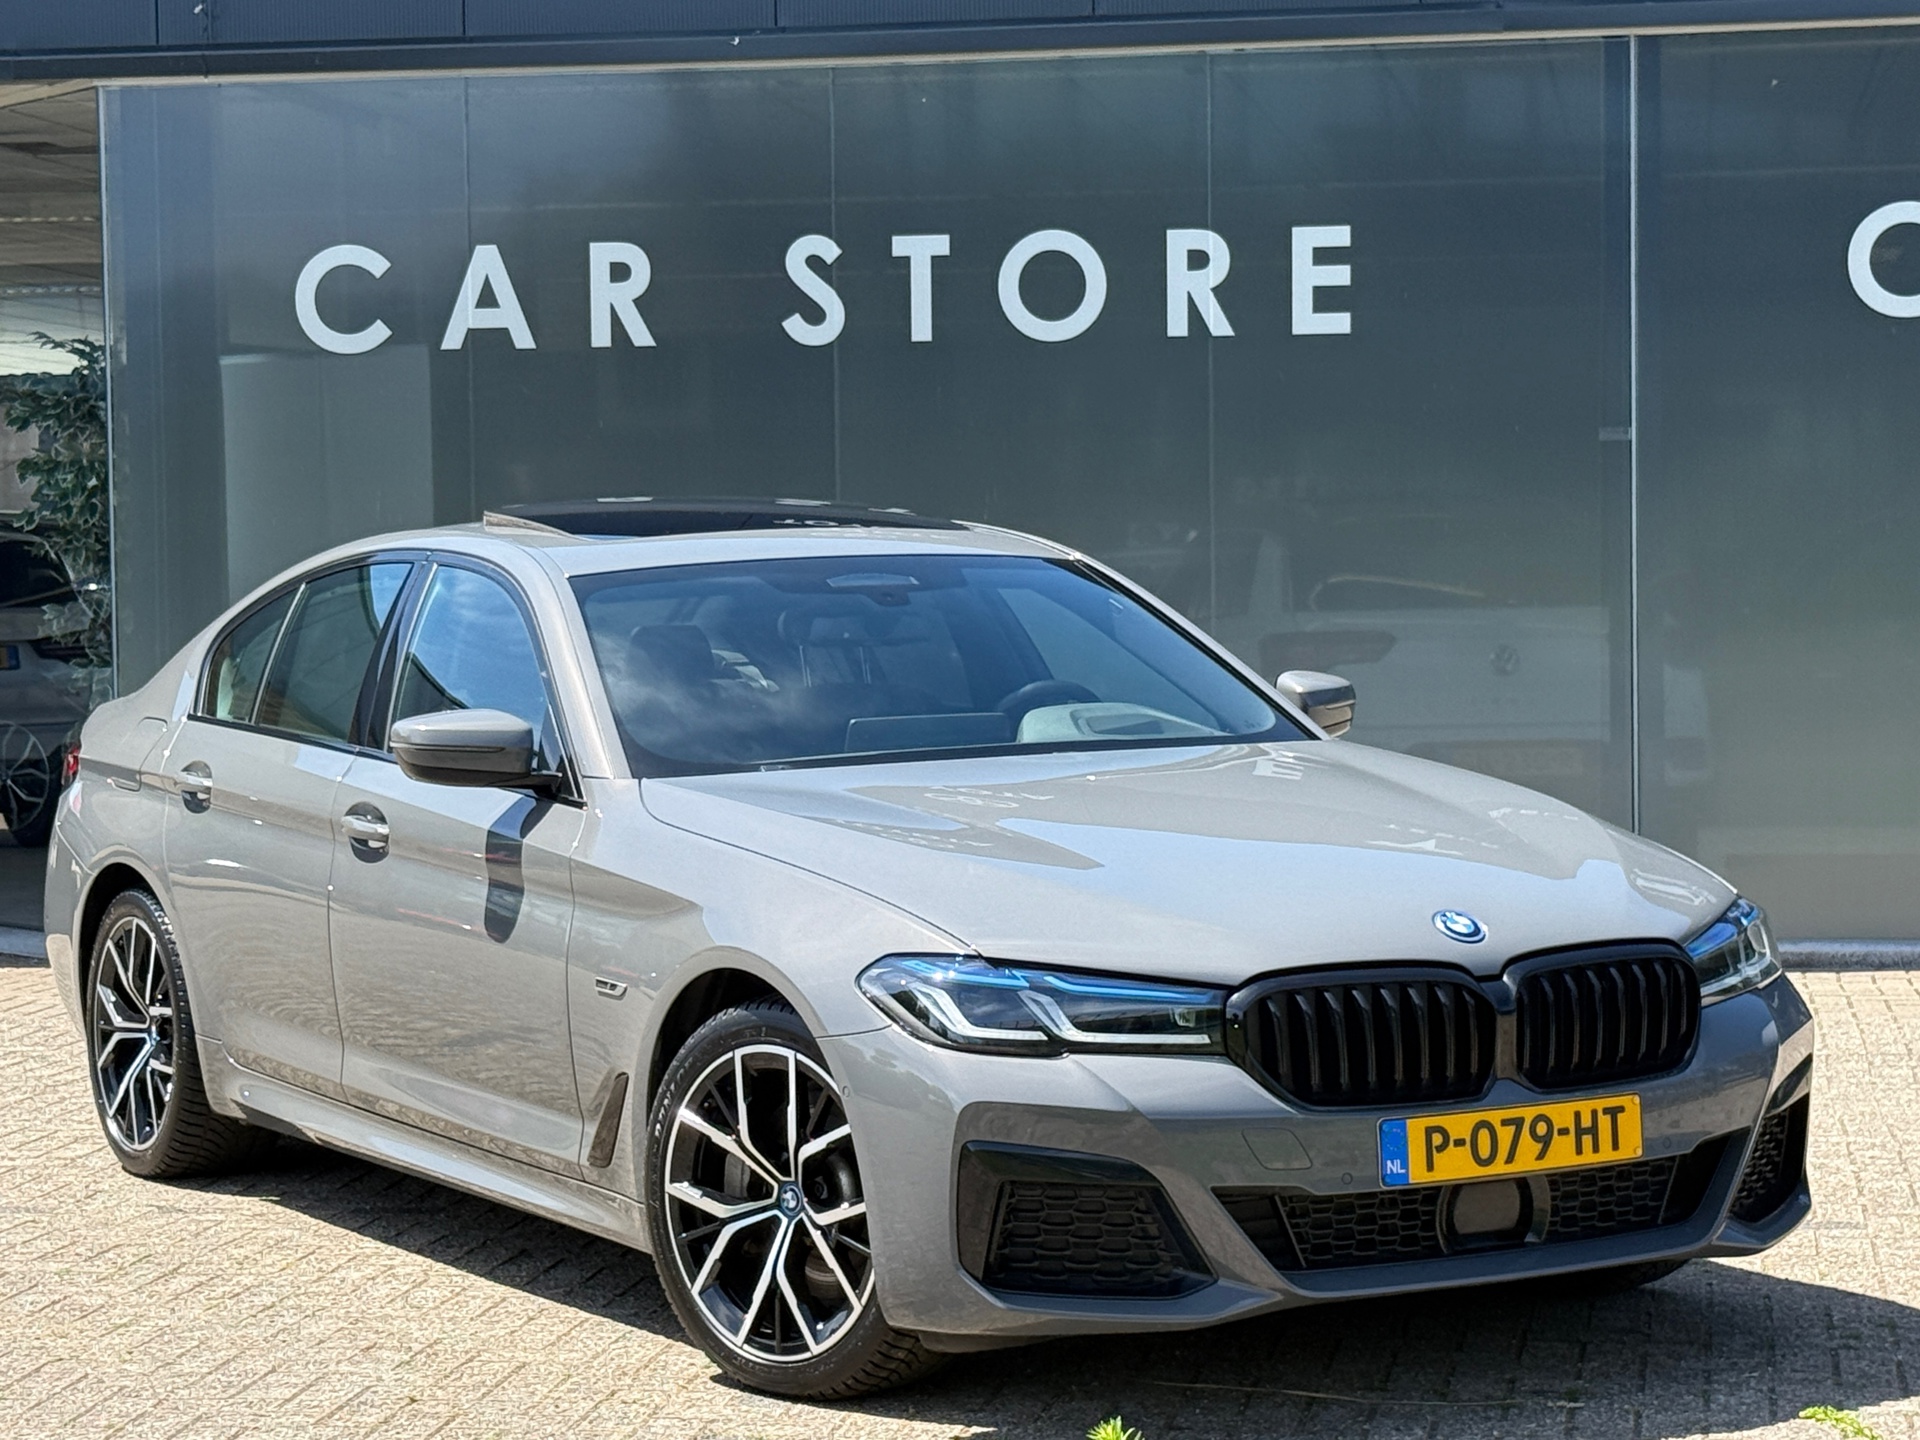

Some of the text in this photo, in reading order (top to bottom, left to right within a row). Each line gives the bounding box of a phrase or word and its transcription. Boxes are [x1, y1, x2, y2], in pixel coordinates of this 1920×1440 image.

[294, 225, 1353, 355] CAR STORE
[1386, 1159, 1406, 1175] NL
[1424, 1105, 1626, 1173] P-079-HT
